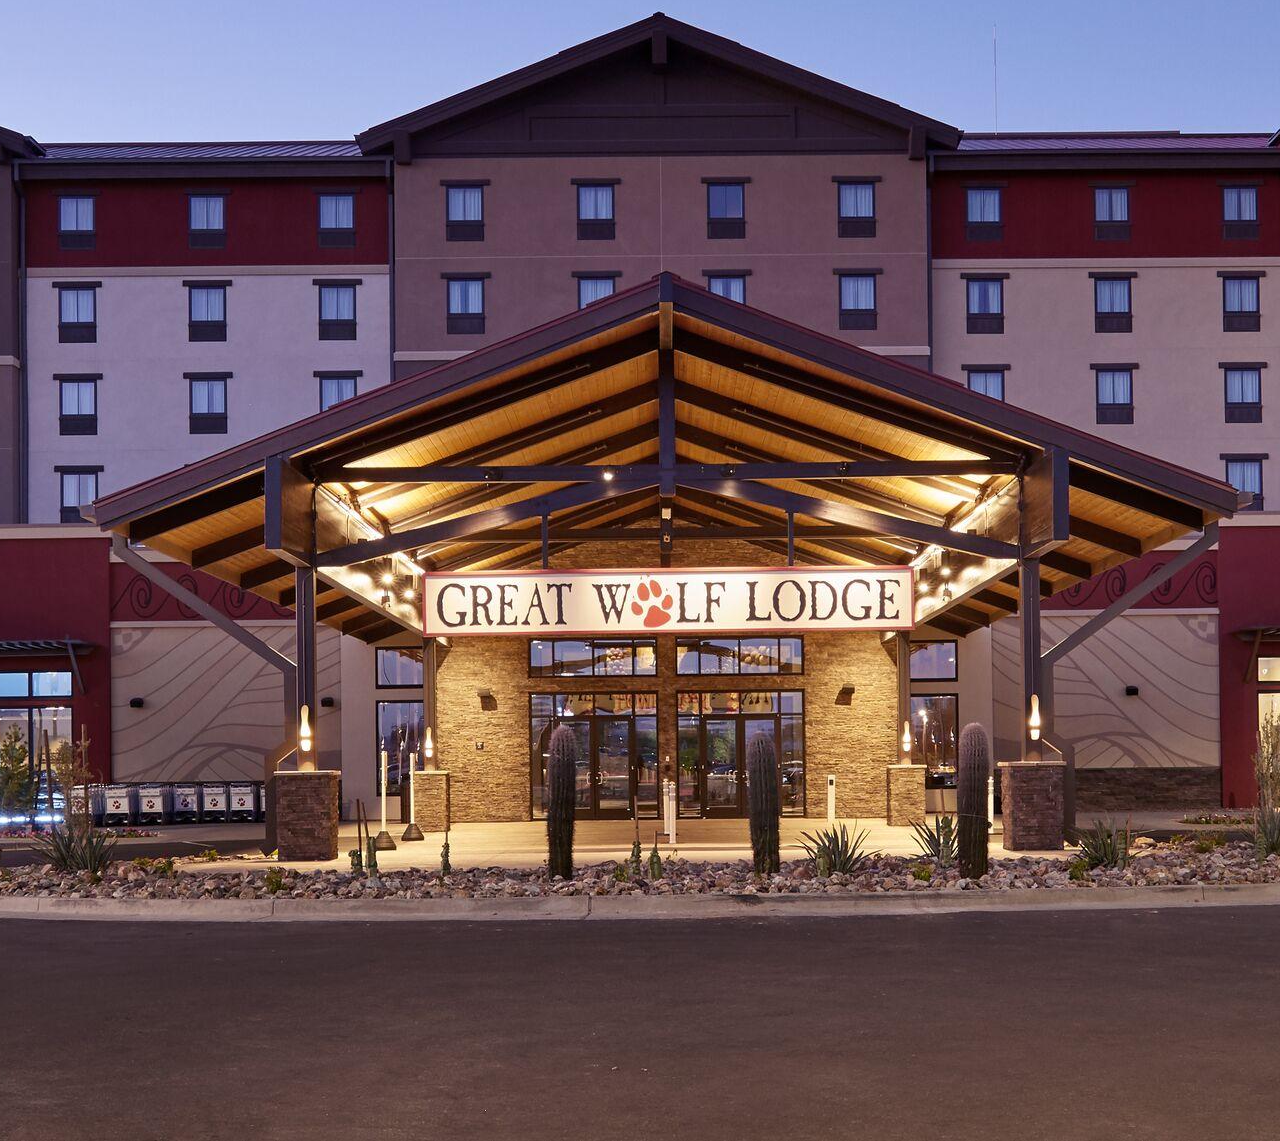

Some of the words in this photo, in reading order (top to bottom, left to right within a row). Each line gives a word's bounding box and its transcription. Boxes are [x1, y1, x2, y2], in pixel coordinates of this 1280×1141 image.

[436, 582, 573, 628] GREAT
[592, 579, 726, 628] WLF
[745, 578, 901, 623] LODGE
